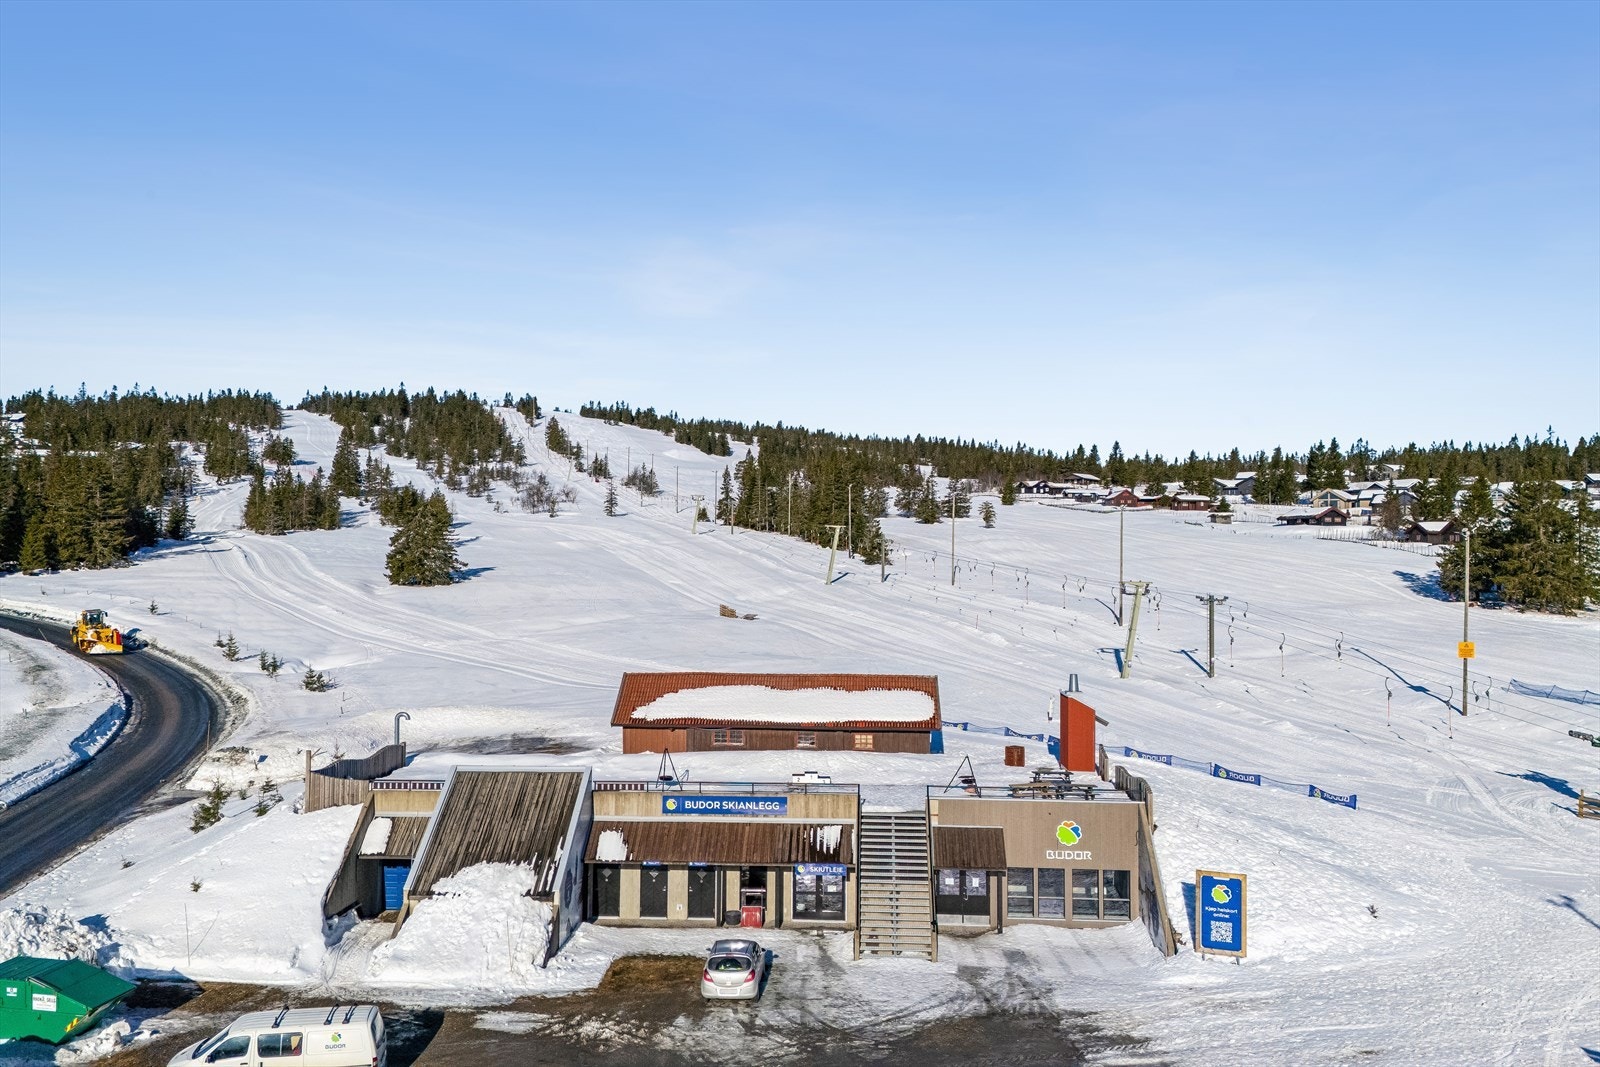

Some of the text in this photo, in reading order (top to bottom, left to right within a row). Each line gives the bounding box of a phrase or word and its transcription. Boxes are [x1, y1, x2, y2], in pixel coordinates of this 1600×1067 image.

[685, 800, 780, 810] BUDOR SKIANLEGG
[1046, 850, 1093, 861] BUDOR
